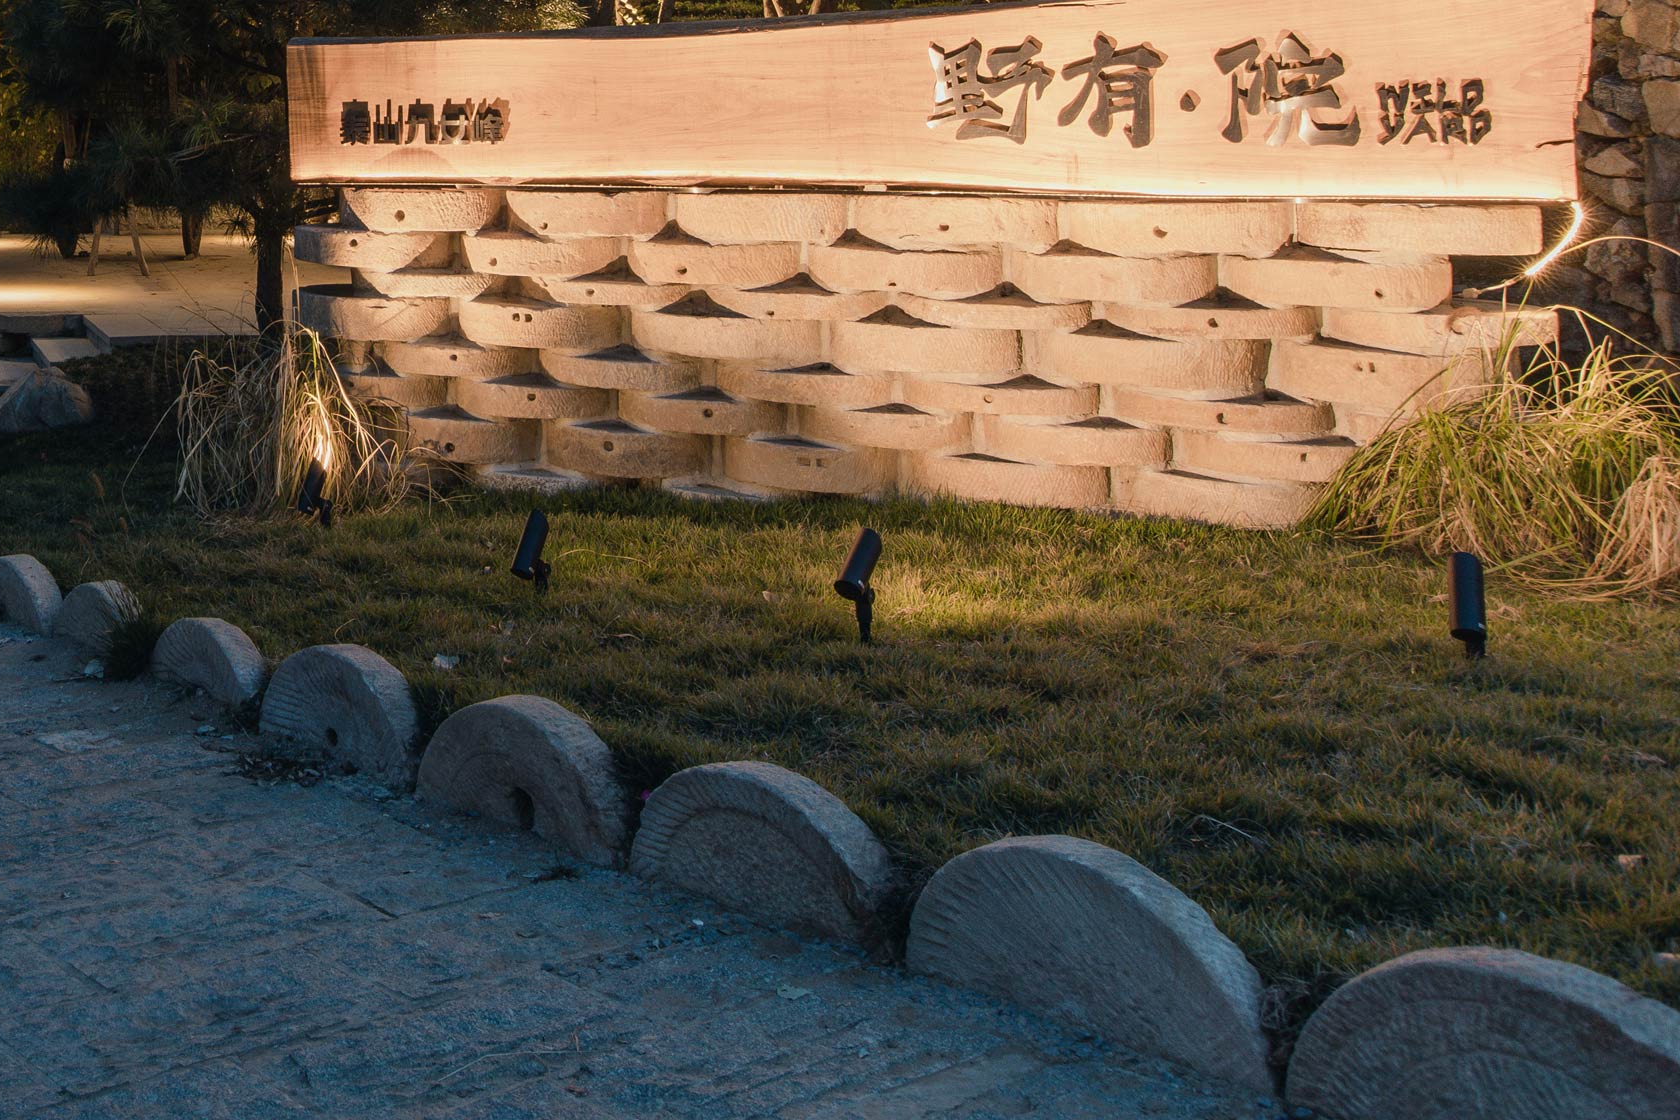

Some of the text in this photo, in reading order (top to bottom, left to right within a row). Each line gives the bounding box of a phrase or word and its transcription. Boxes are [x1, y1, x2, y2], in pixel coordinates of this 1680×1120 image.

[1375, 77, 1485, 116] WILD
[339, 96, 510, 146] 泰山九女峰
[1376, 109, 1493, 145] YARD
